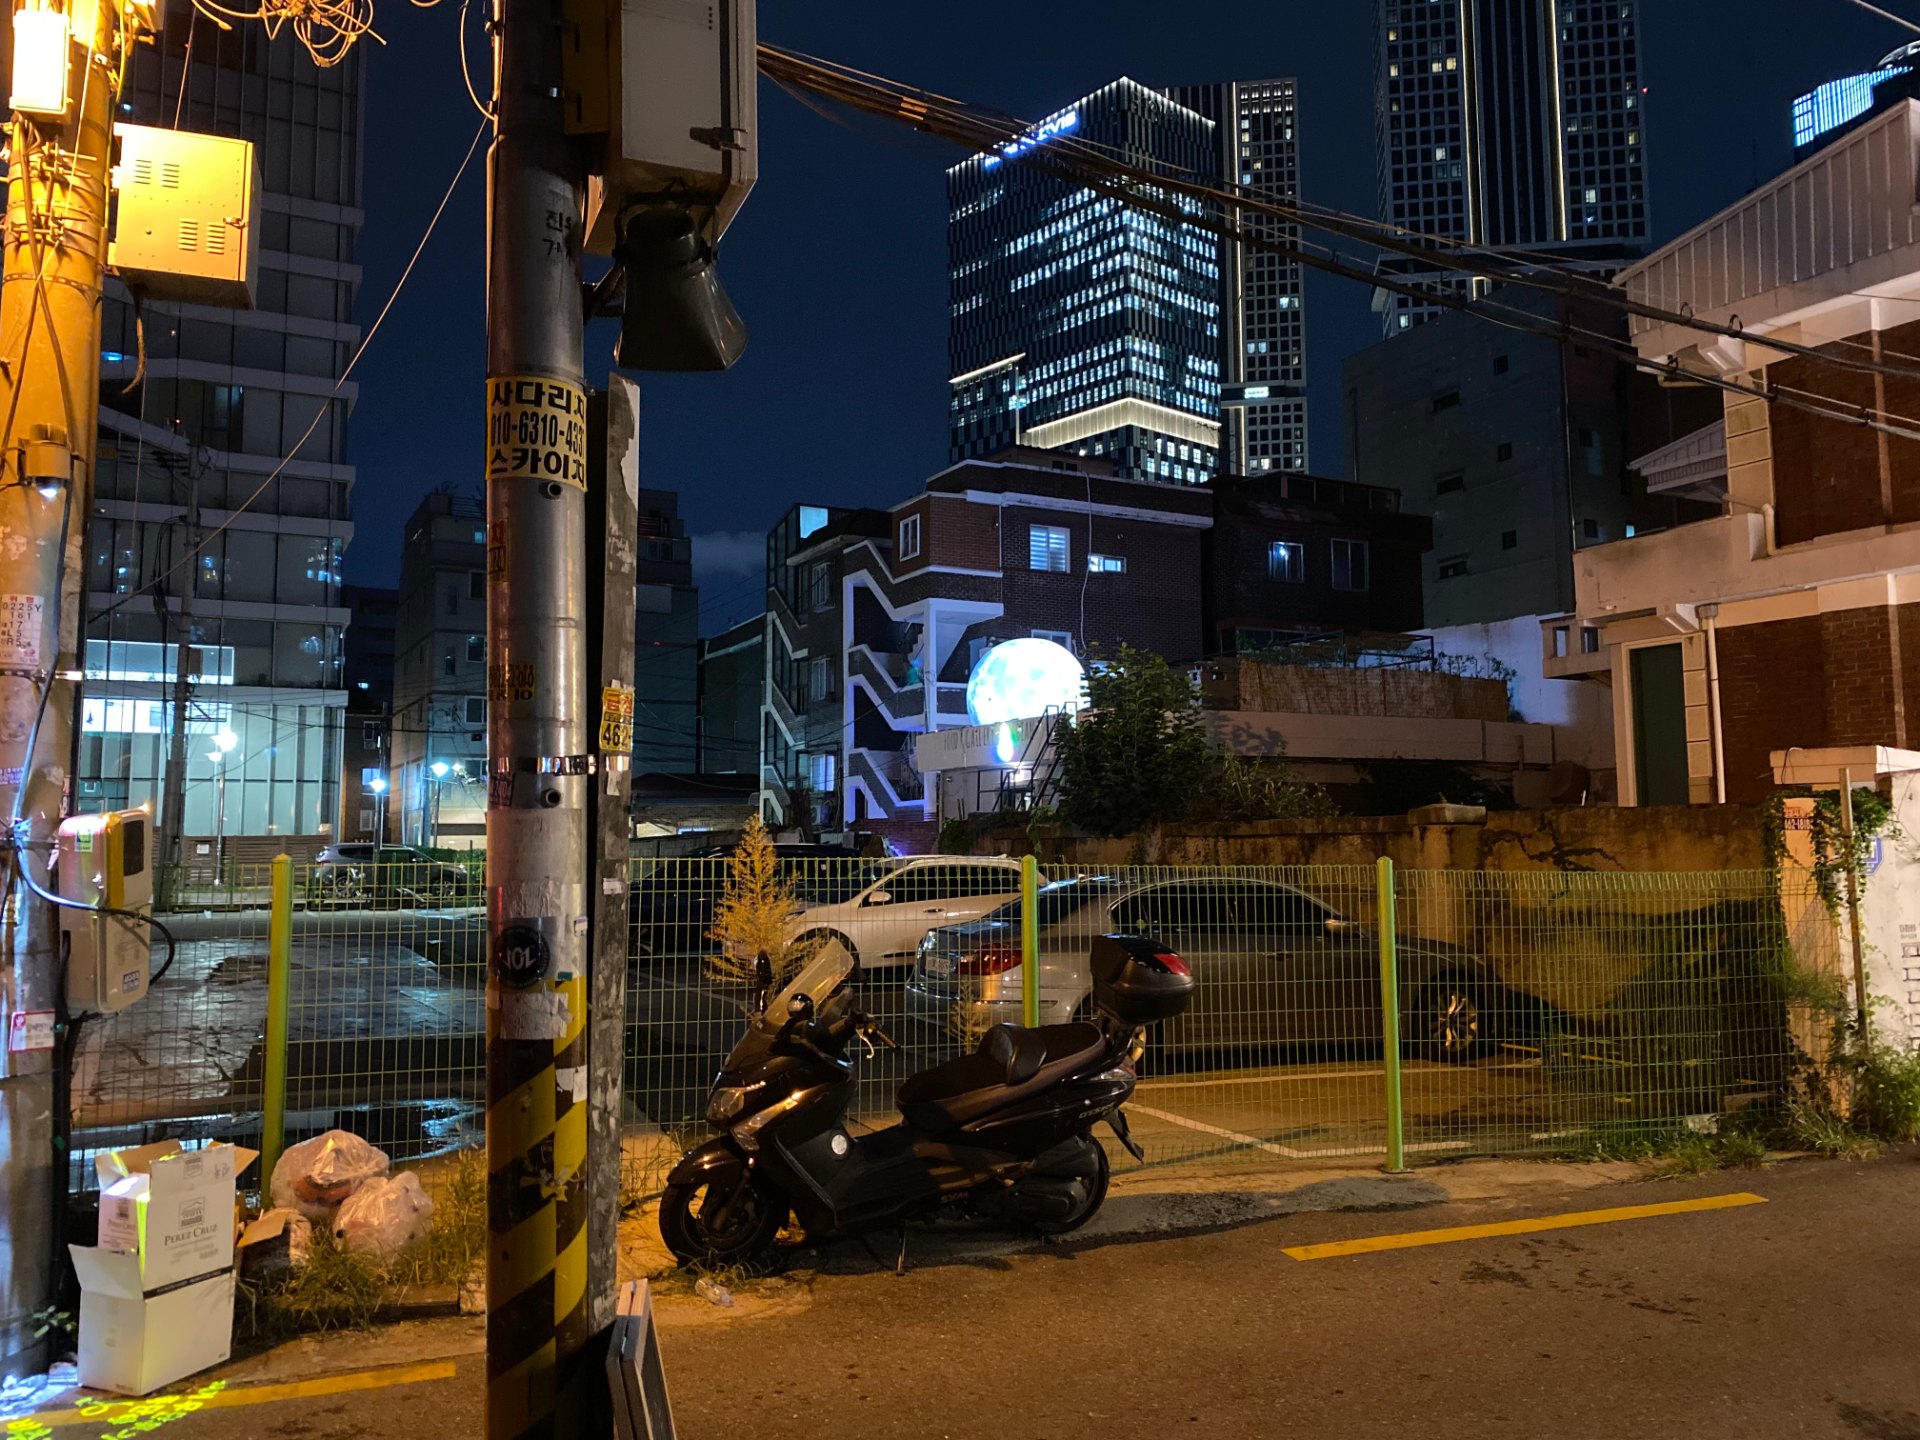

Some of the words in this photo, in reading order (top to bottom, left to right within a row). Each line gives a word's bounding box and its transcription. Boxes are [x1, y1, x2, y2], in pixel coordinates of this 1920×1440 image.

[491, 411, 585, 459] 010-6310-433
[164, 1231, 191, 1247] PEREZ
[193, 1223, 218, 1238] CRUZ
